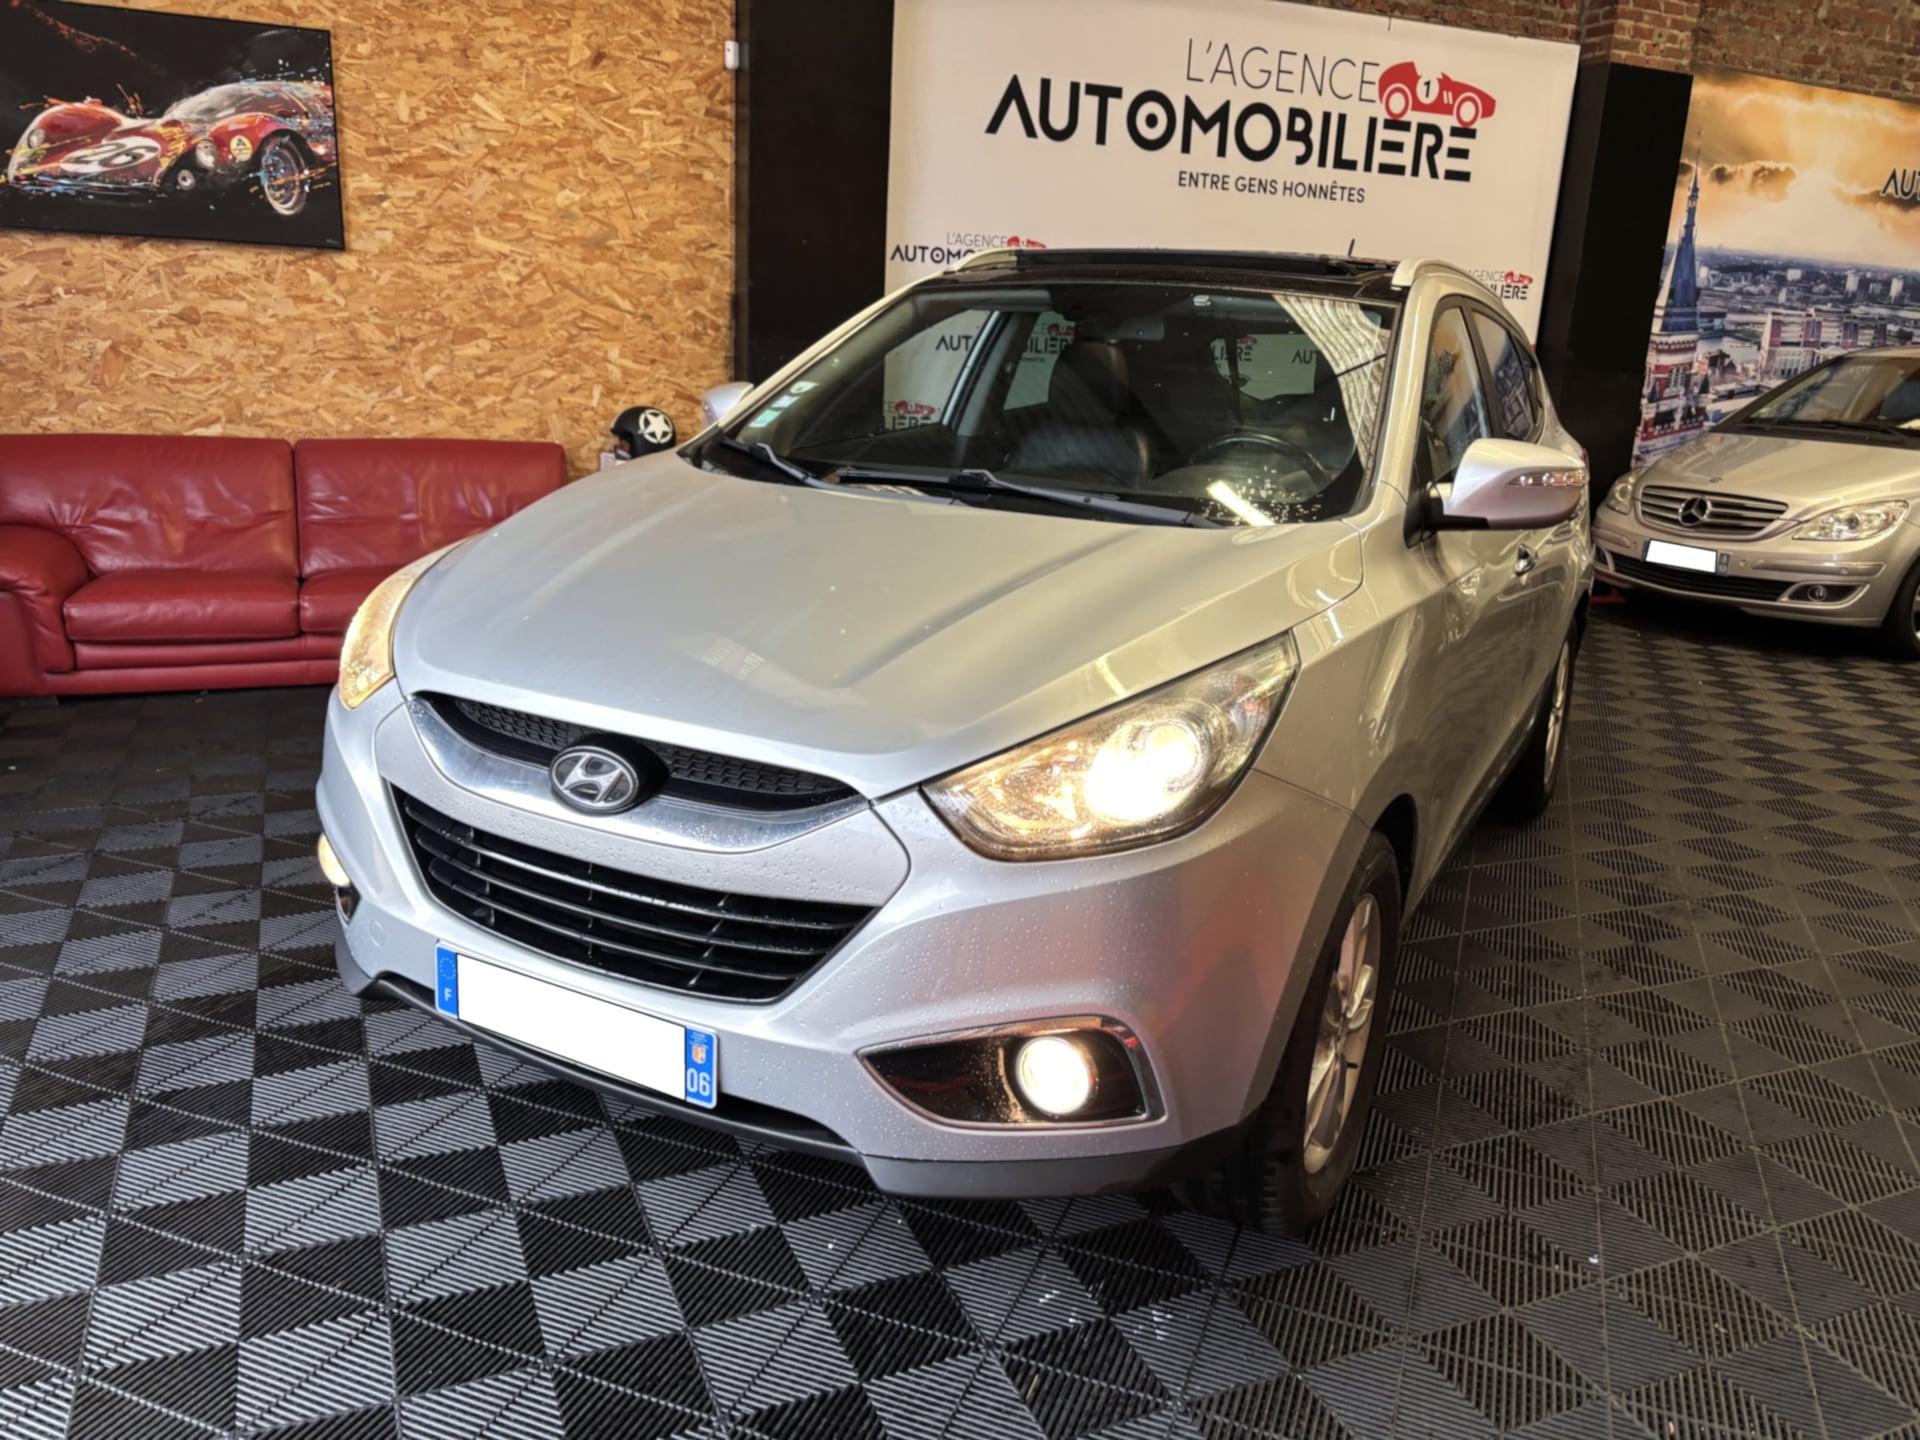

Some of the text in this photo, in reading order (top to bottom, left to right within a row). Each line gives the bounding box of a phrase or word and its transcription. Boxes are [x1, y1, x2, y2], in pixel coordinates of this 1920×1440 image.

[1187, 38, 1380, 103] L'AGENCE
[1178, 170, 1366, 203] ENTRE GENS HONNÊTES
[946, 232, 1007, 248] L'AGENCE
[444, 987, 452, 1002] F
[687, 1067, 710, 1097] 06
